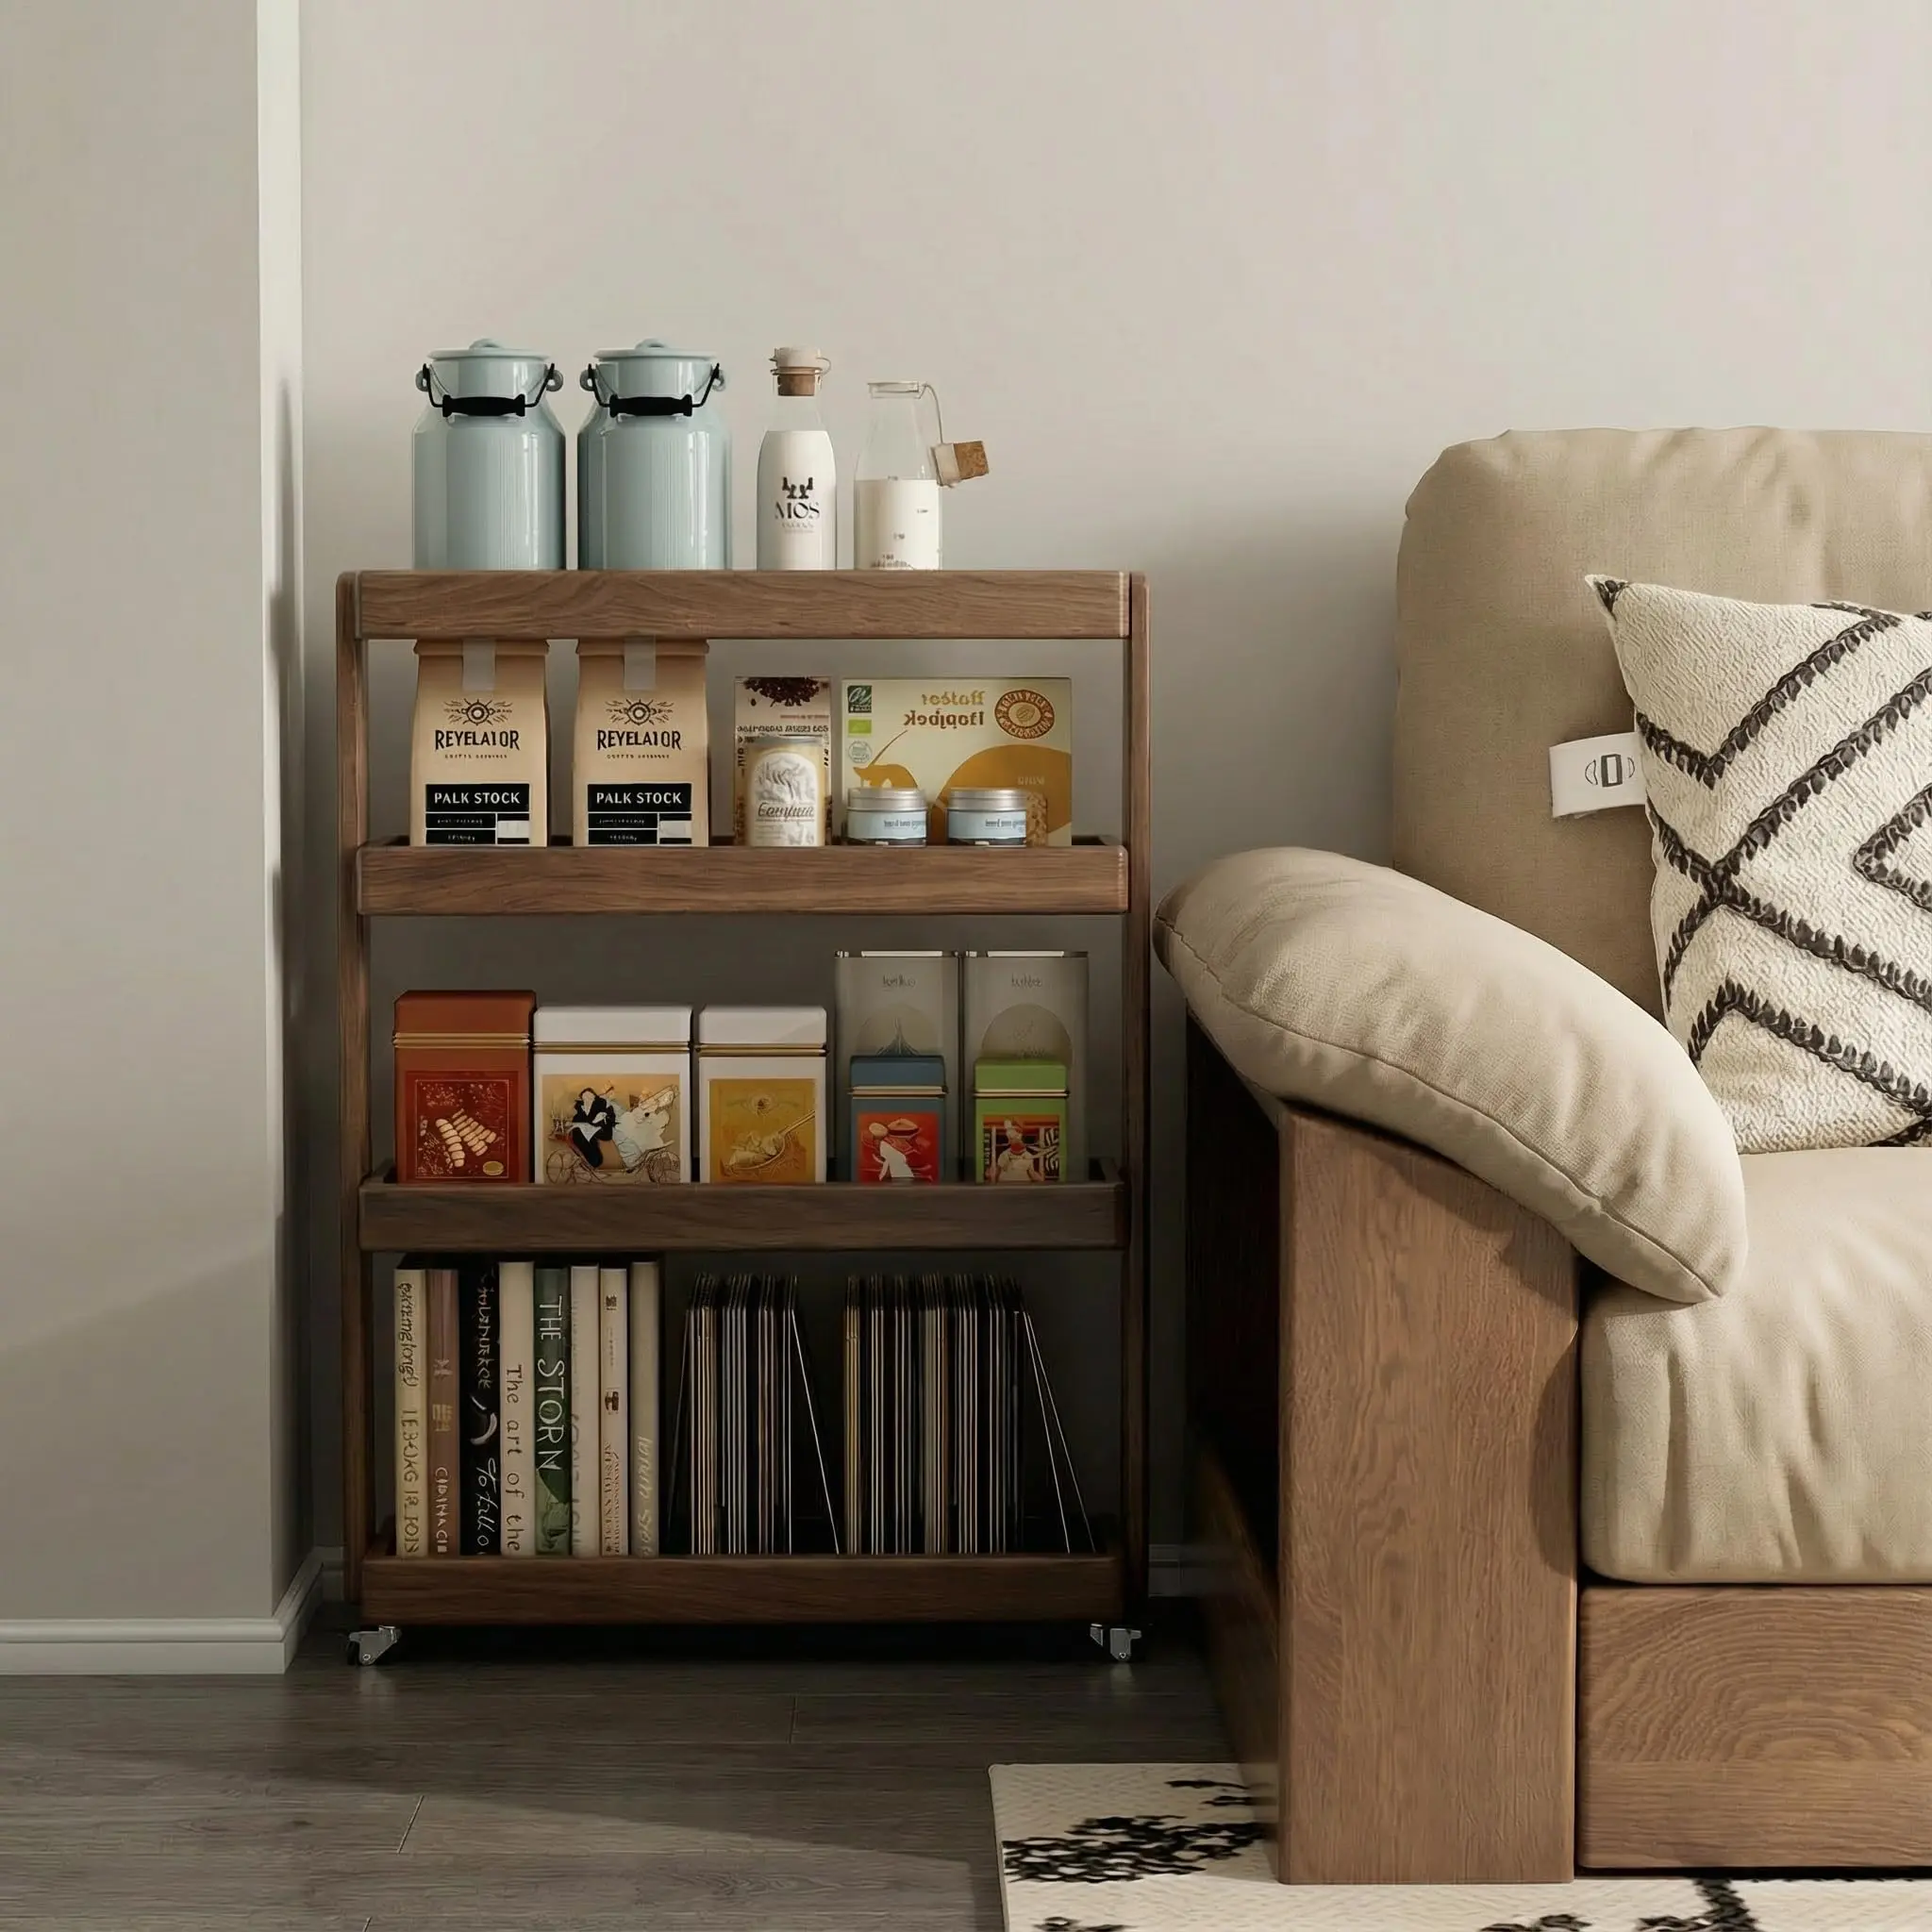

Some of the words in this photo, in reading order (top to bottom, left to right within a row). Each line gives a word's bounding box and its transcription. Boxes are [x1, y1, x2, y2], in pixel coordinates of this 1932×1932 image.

[774, 502, 820, 520] MOS
[434, 792, 469, 804] PALK
[474, 792, 521, 804] STOCK
[596, 792, 632, 804] PALK
[636, 792, 682, 804] STOCK
[539, 1295, 564, 1340] THE
[506, 1364, 524, 1404] The
[506, 1420, 523, 1457] art
[506, 1473, 525, 1499] of
[506, 1515, 525, 1551] the
